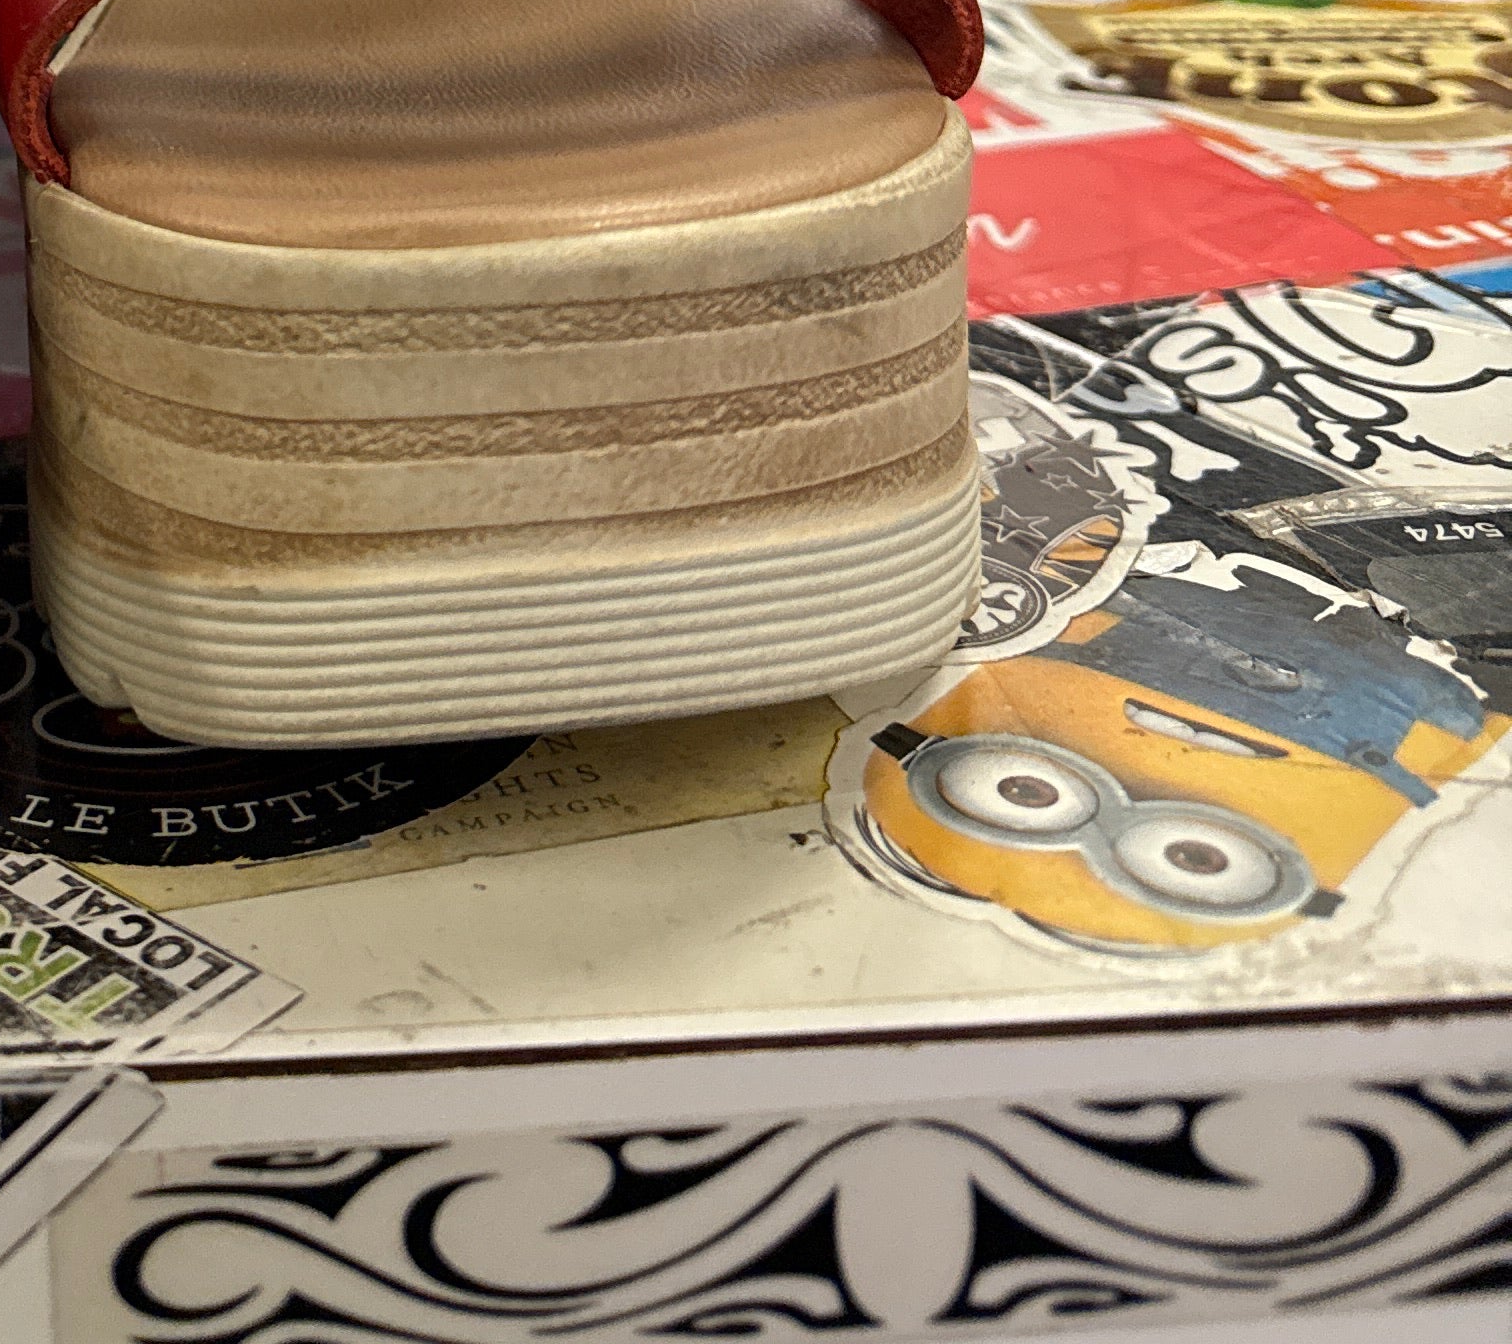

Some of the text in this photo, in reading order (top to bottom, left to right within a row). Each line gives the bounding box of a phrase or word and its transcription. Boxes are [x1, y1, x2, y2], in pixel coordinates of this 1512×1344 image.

[1402, 521, 1505, 542] 5474
[151, 762, 415, 838] BUTIK
[399, 793, 621, 841] CAMPAIGN
[45, 872, 233, 993] LOCAL
